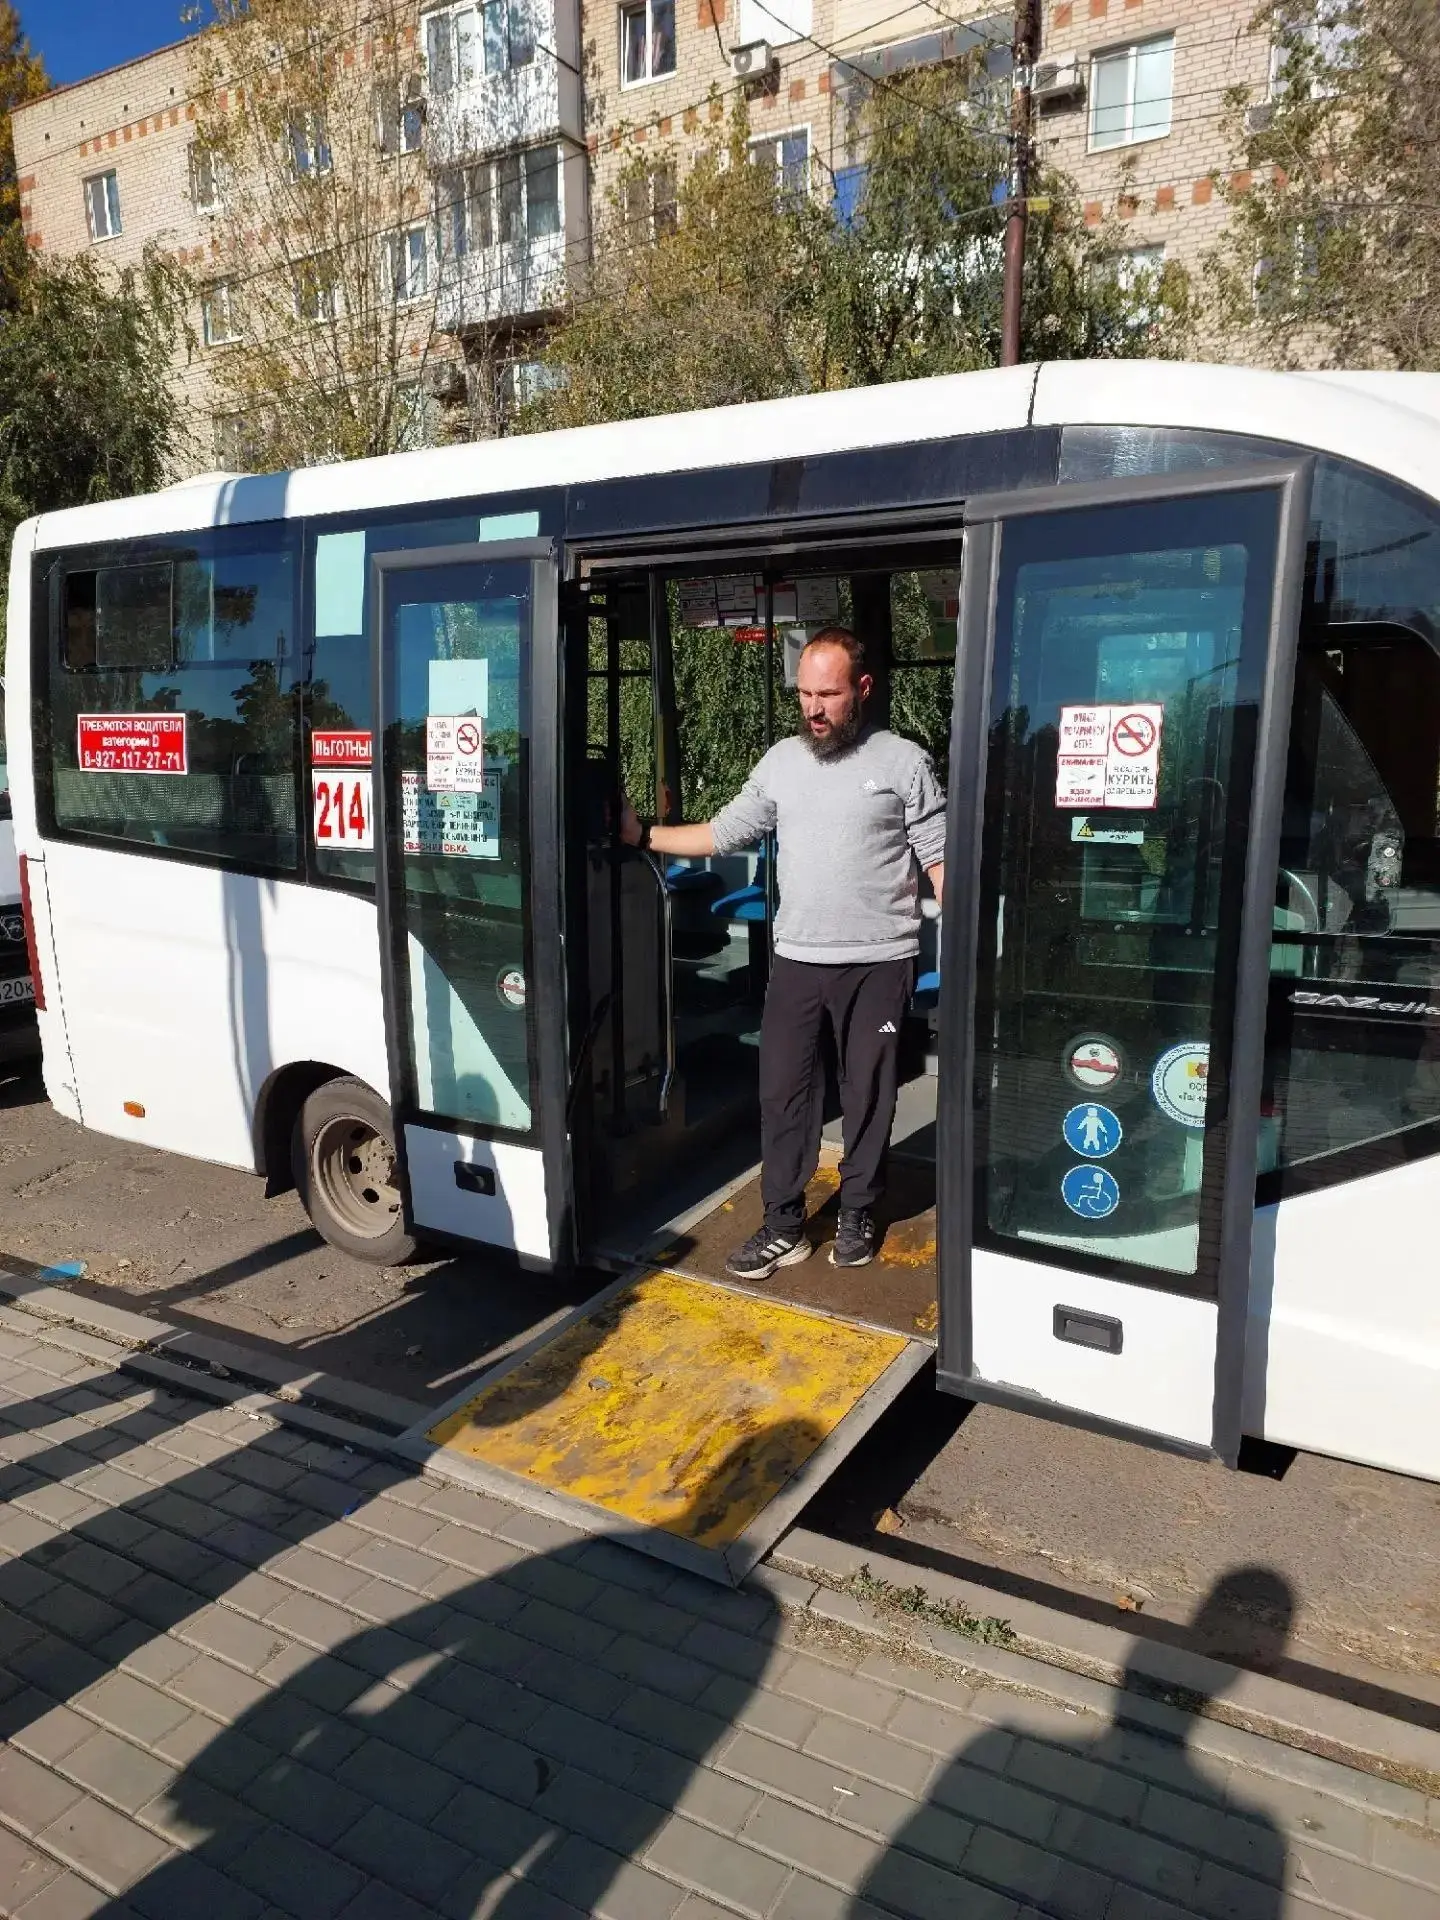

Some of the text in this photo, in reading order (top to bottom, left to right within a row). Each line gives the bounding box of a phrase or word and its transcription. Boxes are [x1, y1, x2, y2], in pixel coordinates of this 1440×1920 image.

[81, 720, 182, 733] ТРЕБУЮТСЯ ВОДИТЕЛИ
[102, 734, 160, 750] категории D
[84, 750, 181, 770] 8-927-117-27-71
[1108, 774, 1154, 785] КУРИТЬ
[316, 781, 366, 840] 214
[0, 980, 35, 1000] 20К
